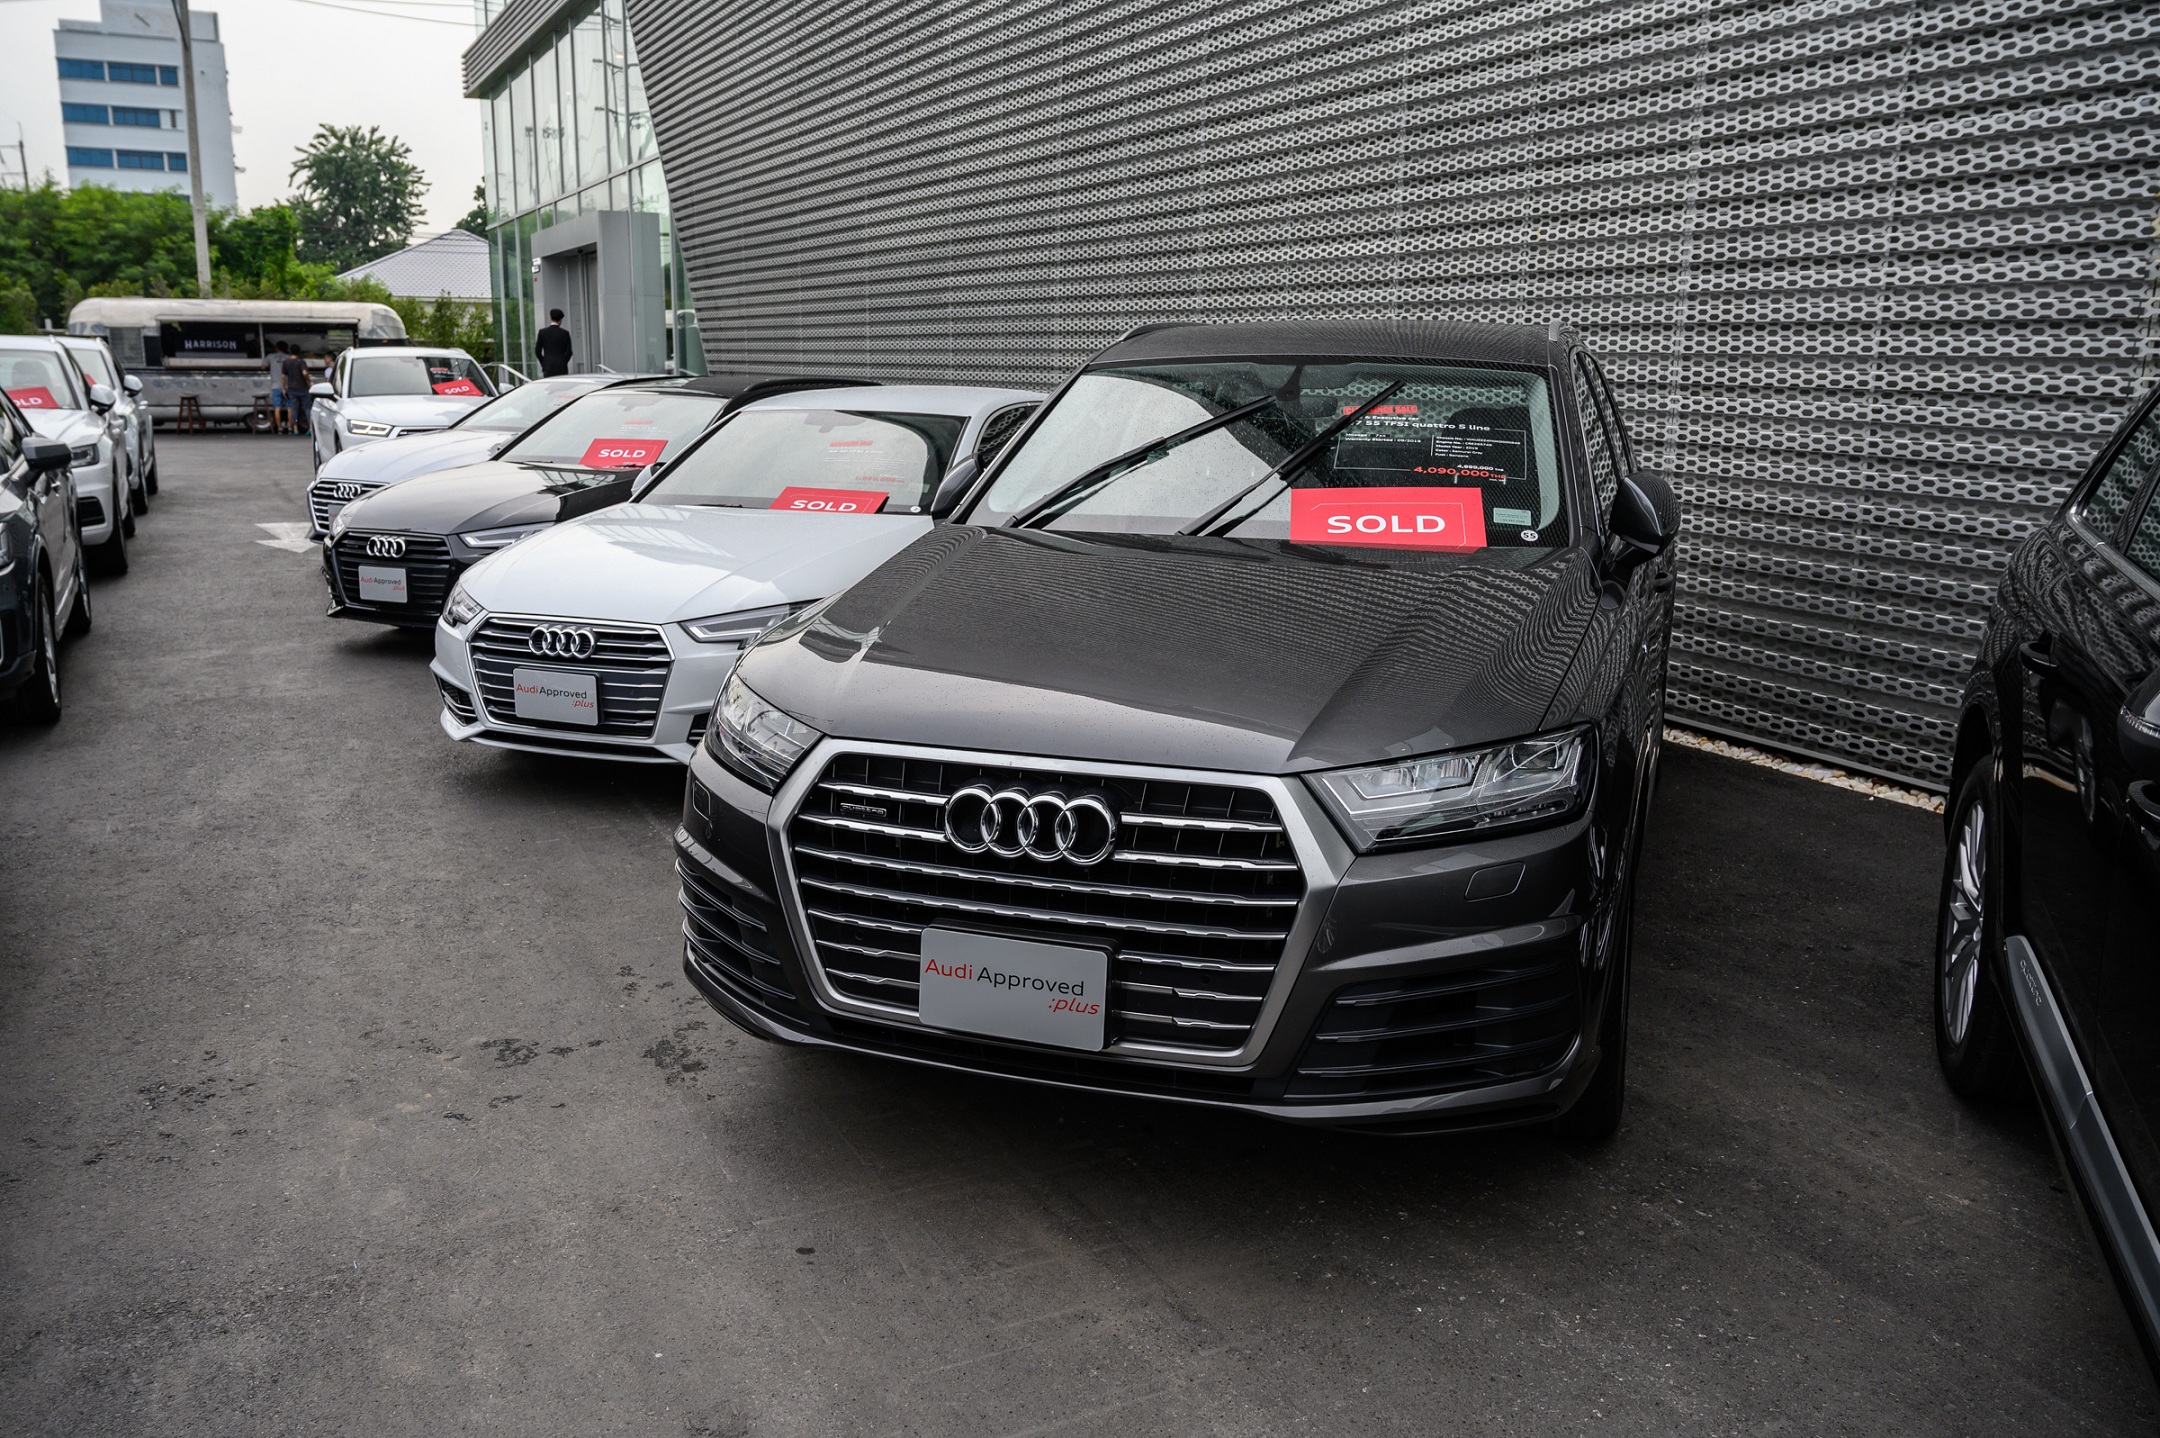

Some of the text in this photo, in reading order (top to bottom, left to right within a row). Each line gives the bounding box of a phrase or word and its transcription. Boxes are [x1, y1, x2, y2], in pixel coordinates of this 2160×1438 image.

[184, 339, 237, 349] HARRISON
[444, 385, 470, 395] SOLD
[13, 397, 42, 407] OLD
[598, 449, 646, 458] SOLD
[1413, 466, 1489, 478] 4,090,000
[790, 500, 857, 512] SOLD
[1327, 515, 1446, 534] SOLD
[360, 576, 402, 585] Audi Approved
[516, 683, 587, 699] Audi Approved
[925, 958, 1084, 997] Audi Approved
[2019, 959, 2042, 1007] quattro
[1048, 997, 1100, 1015] :plus
